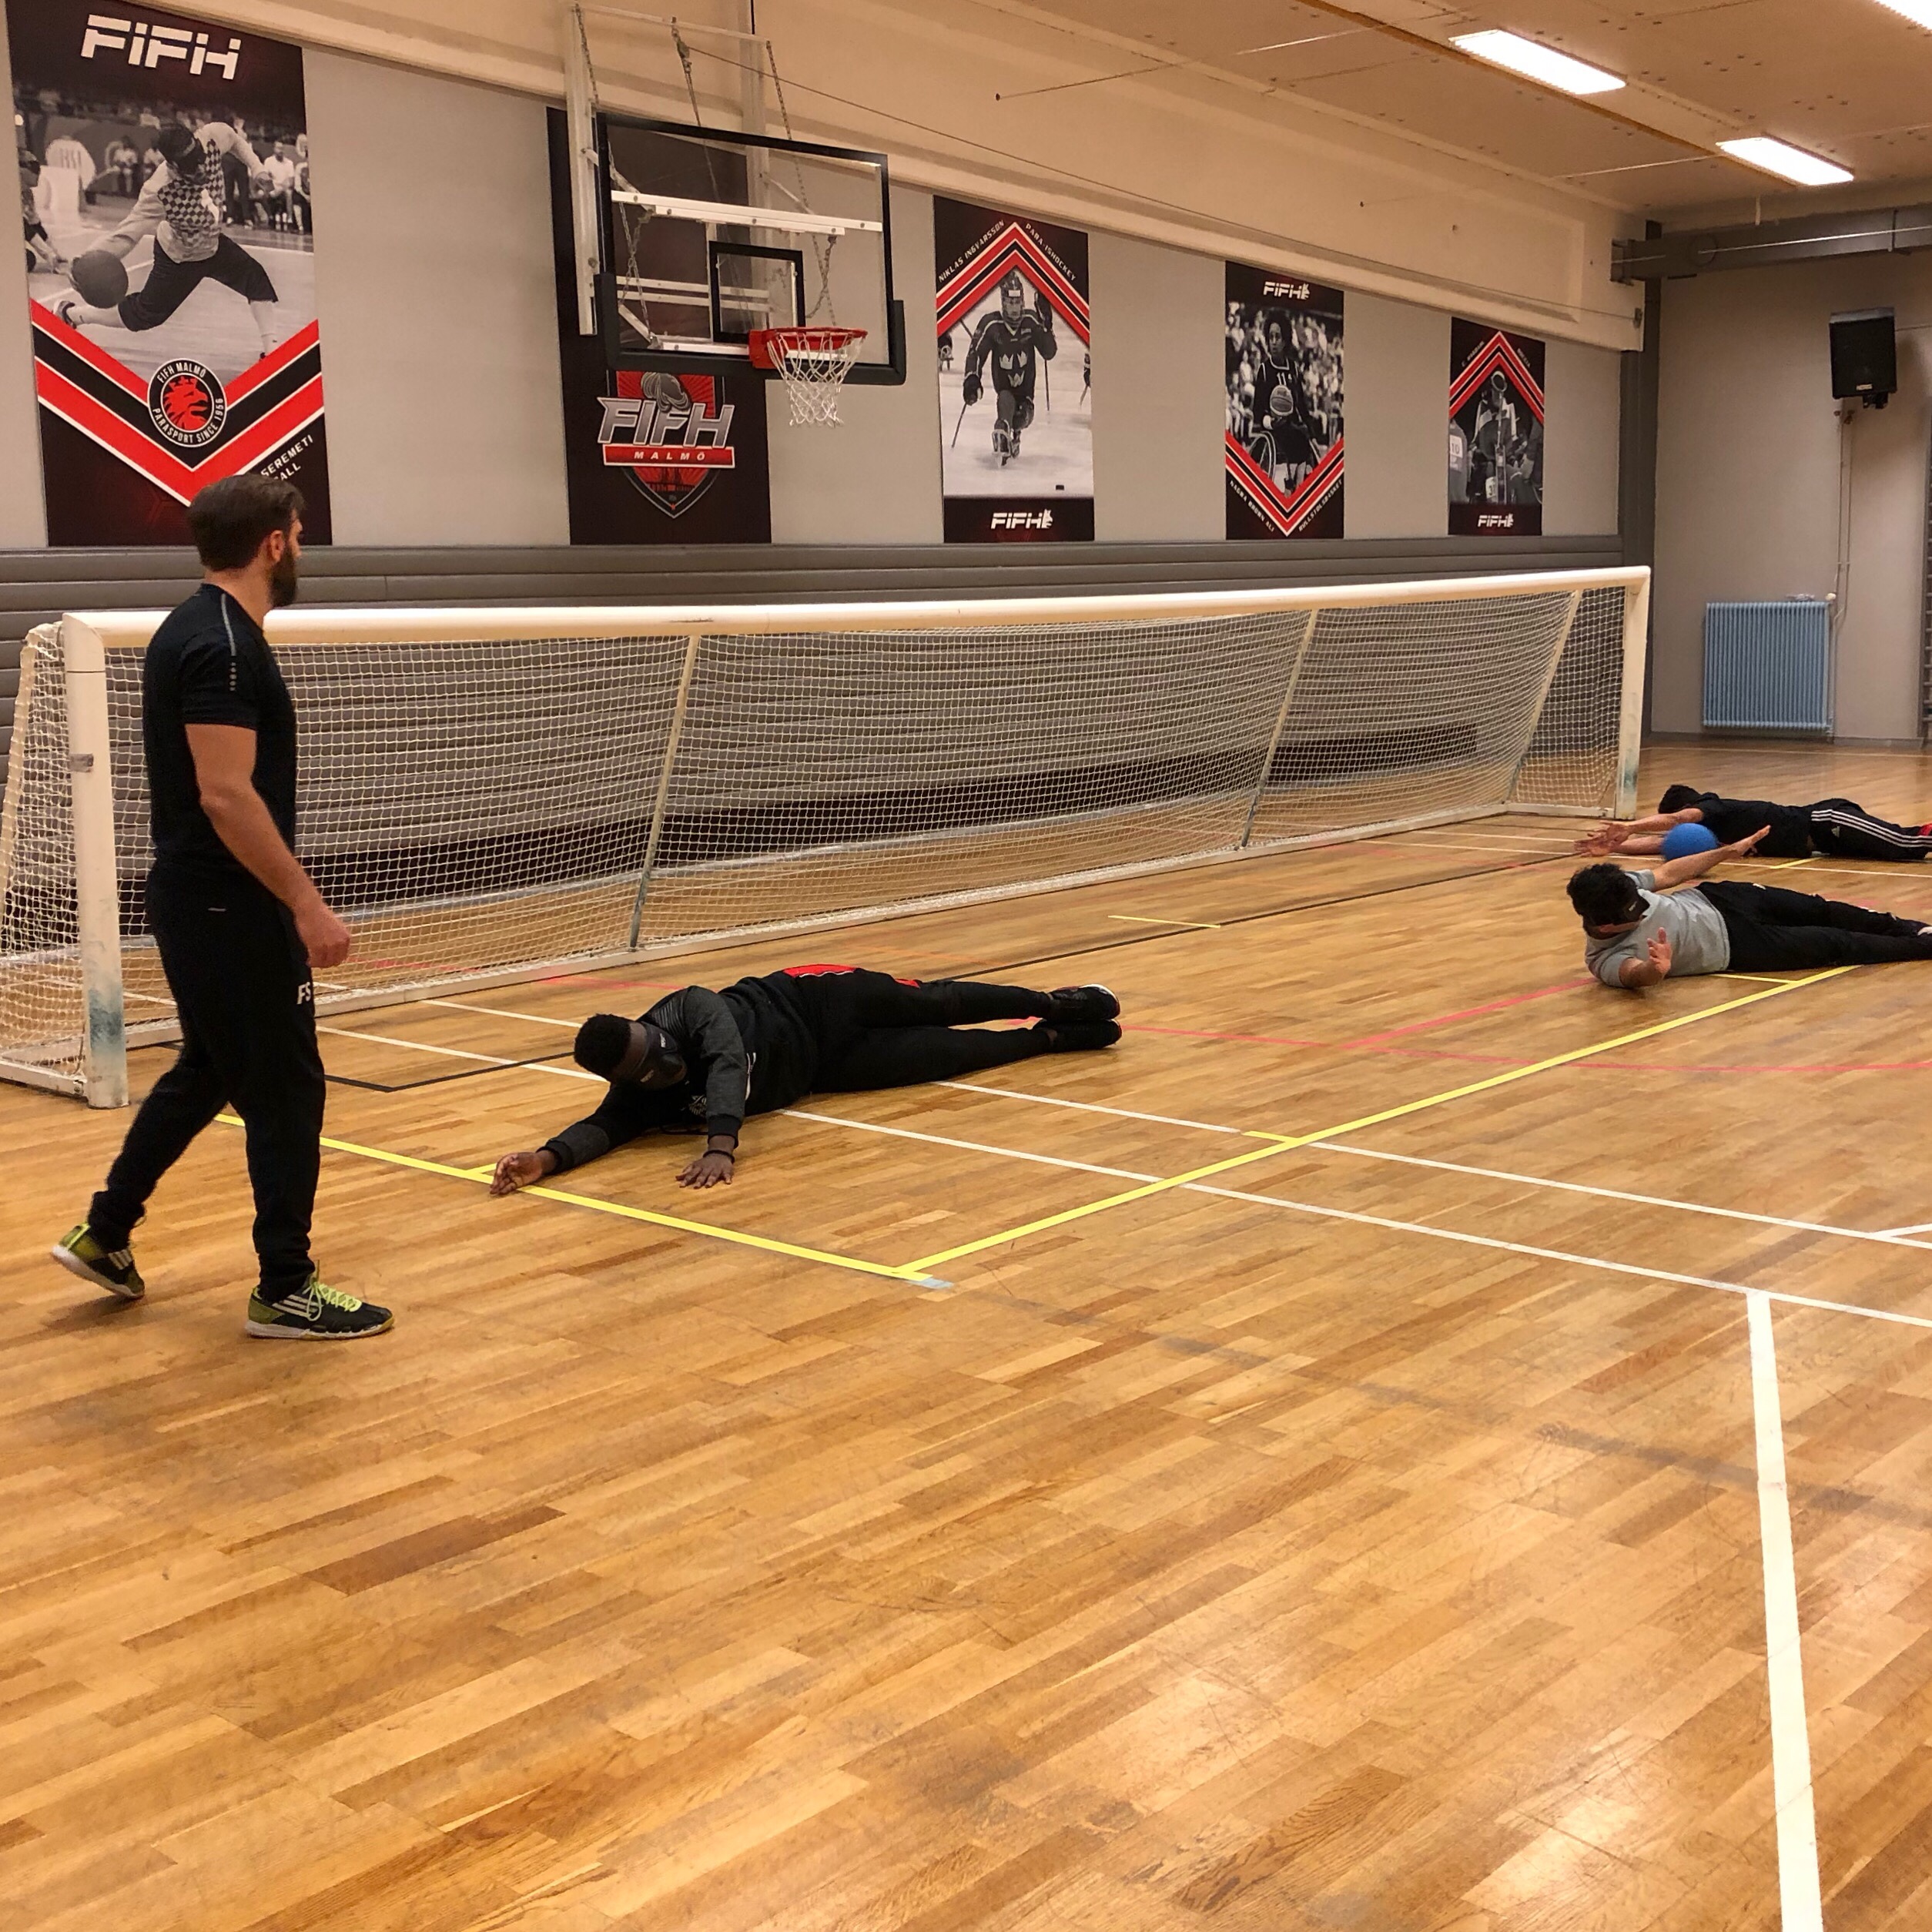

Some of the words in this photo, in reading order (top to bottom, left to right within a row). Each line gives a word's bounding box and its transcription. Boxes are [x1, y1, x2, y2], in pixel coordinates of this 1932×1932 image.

[938, 256, 964, 283] NIKLAS
[964, 219, 1005, 259] INGVARSSON
[156, 364, 176, 383] FIFH
[152, 407, 193, 444] PARASPORT
[196, 422, 219, 443] SINCE
[213, 398, 224, 421] 1956
[597, 397, 735, 448] FIFH
[260, 434, 313, 477] SEREMETI
[634, 450, 705, 461] MALMÖ
[273, 463, 302, 480] ALL
[990, 512, 1043, 529] FIFH
